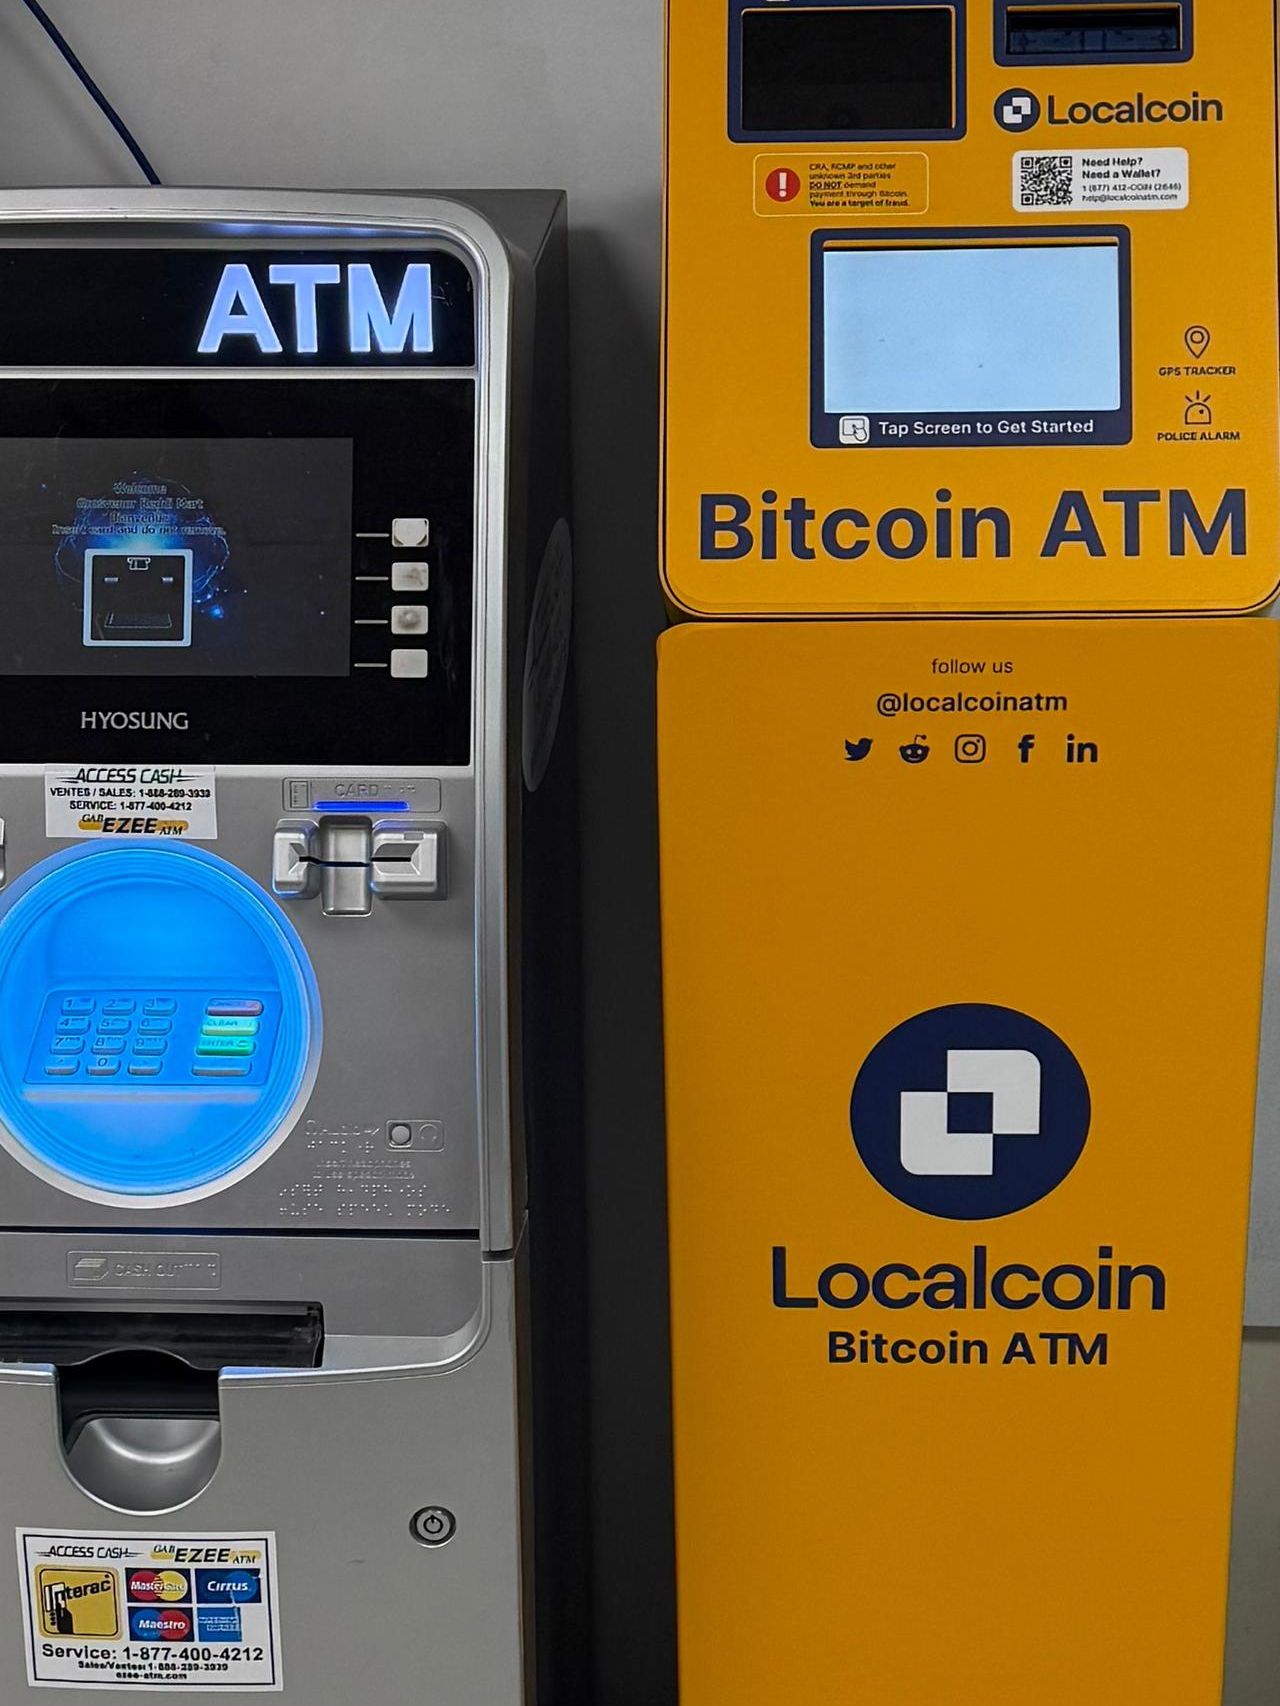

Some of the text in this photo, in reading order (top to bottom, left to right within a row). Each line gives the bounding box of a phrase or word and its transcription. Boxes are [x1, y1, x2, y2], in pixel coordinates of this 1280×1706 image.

[1047, 92, 1223, 126] Localcoin
[1082, 157, 1143, 168] Need Help?
[1082, 169, 1161, 179] Need Wallet?
[197, 263, 433, 353] ATM
[1158, 366, 1236, 376] GPS TRACKER
[878, 418, 1094, 437] Tap Screen to Get Started
[1157, 432, 1241, 441] POLICE ALARM
[699, 488, 1247, 561] Bitcoin ATM
[931, 658, 1013, 674] follow us
[876, 692, 1068, 717] @localcoinatm
[80, 711, 189, 730] HYOSUNG
[75, 768, 182, 784] ACCESS CASH
[50, 788, 90, 797] VENTES
[335, 783, 379, 798] CARD
[70, 801, 193, 811] SERVICE: 1-877-400-4212
[102, 818, 158, 833] EZEE
[771, 1245, 1166, 1310] Localcoin
[828, 1330, 1108, 1365] Bitcoin ATM
[49, 1545, 256, 1564] ACCESS CASH EZEE ATM
[207, 1580, 249, 1592] Cirrus
[139, 1619, 186, 1630] Maestro
[42, 1644, 264, 1662] Service: 1-877-400-4212
